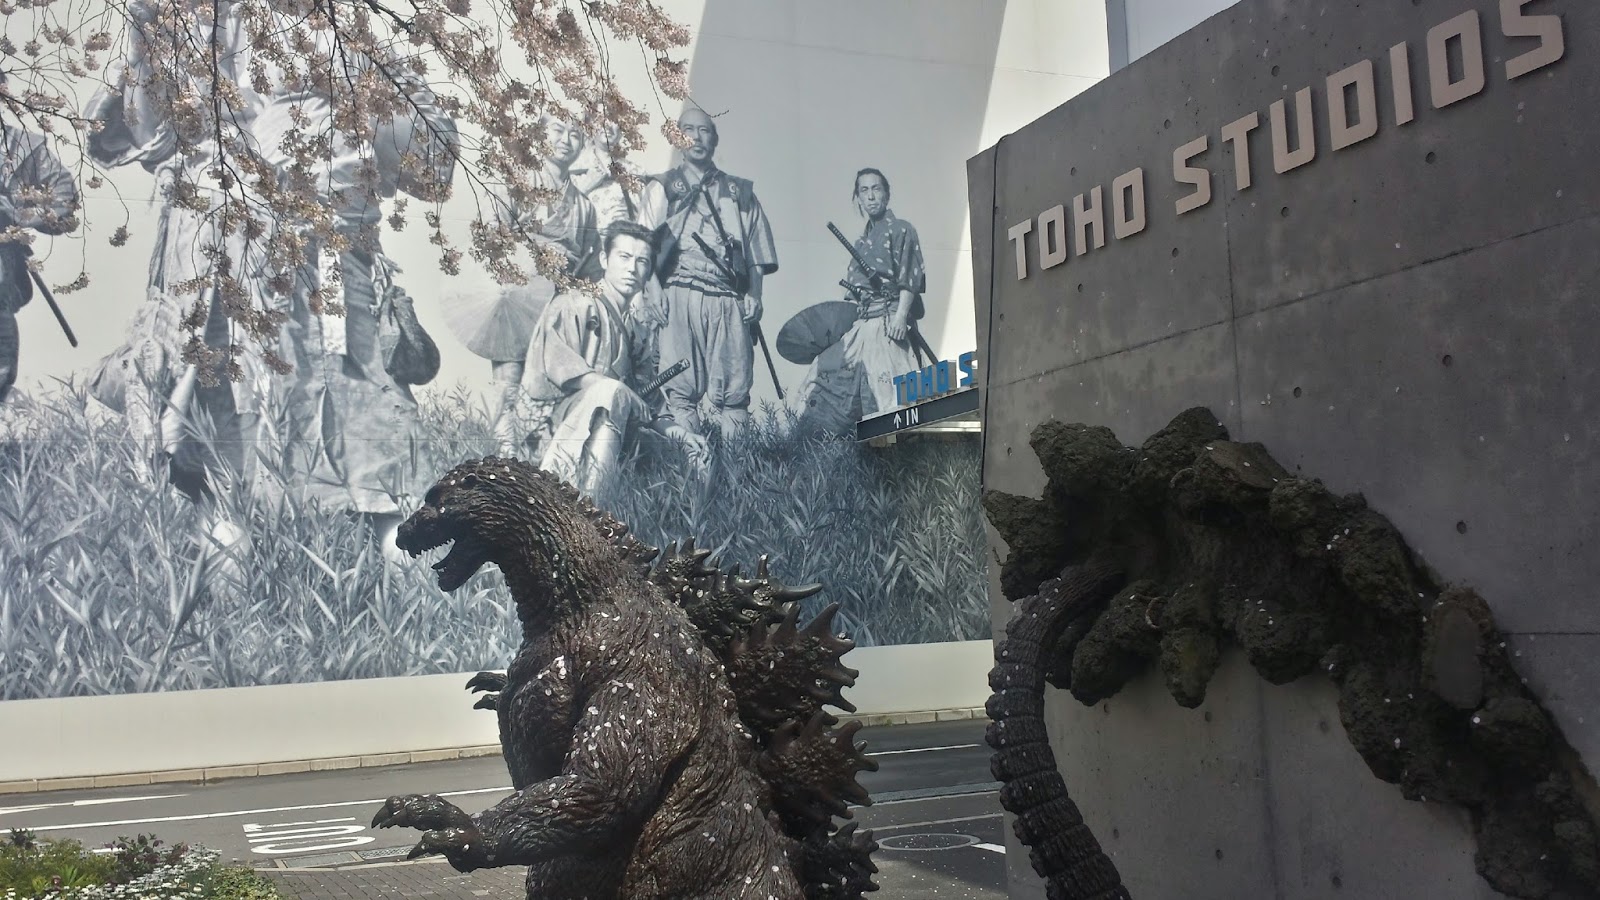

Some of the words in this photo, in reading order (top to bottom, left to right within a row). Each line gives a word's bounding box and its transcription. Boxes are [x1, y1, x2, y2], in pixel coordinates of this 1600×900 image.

[1008, 167, 1146, 280] TOHO
[1173, 0, 1565, 215] STUDIOS
[893, 359, 949, 406] TOHO
[906, 407, 919, 426] IN
